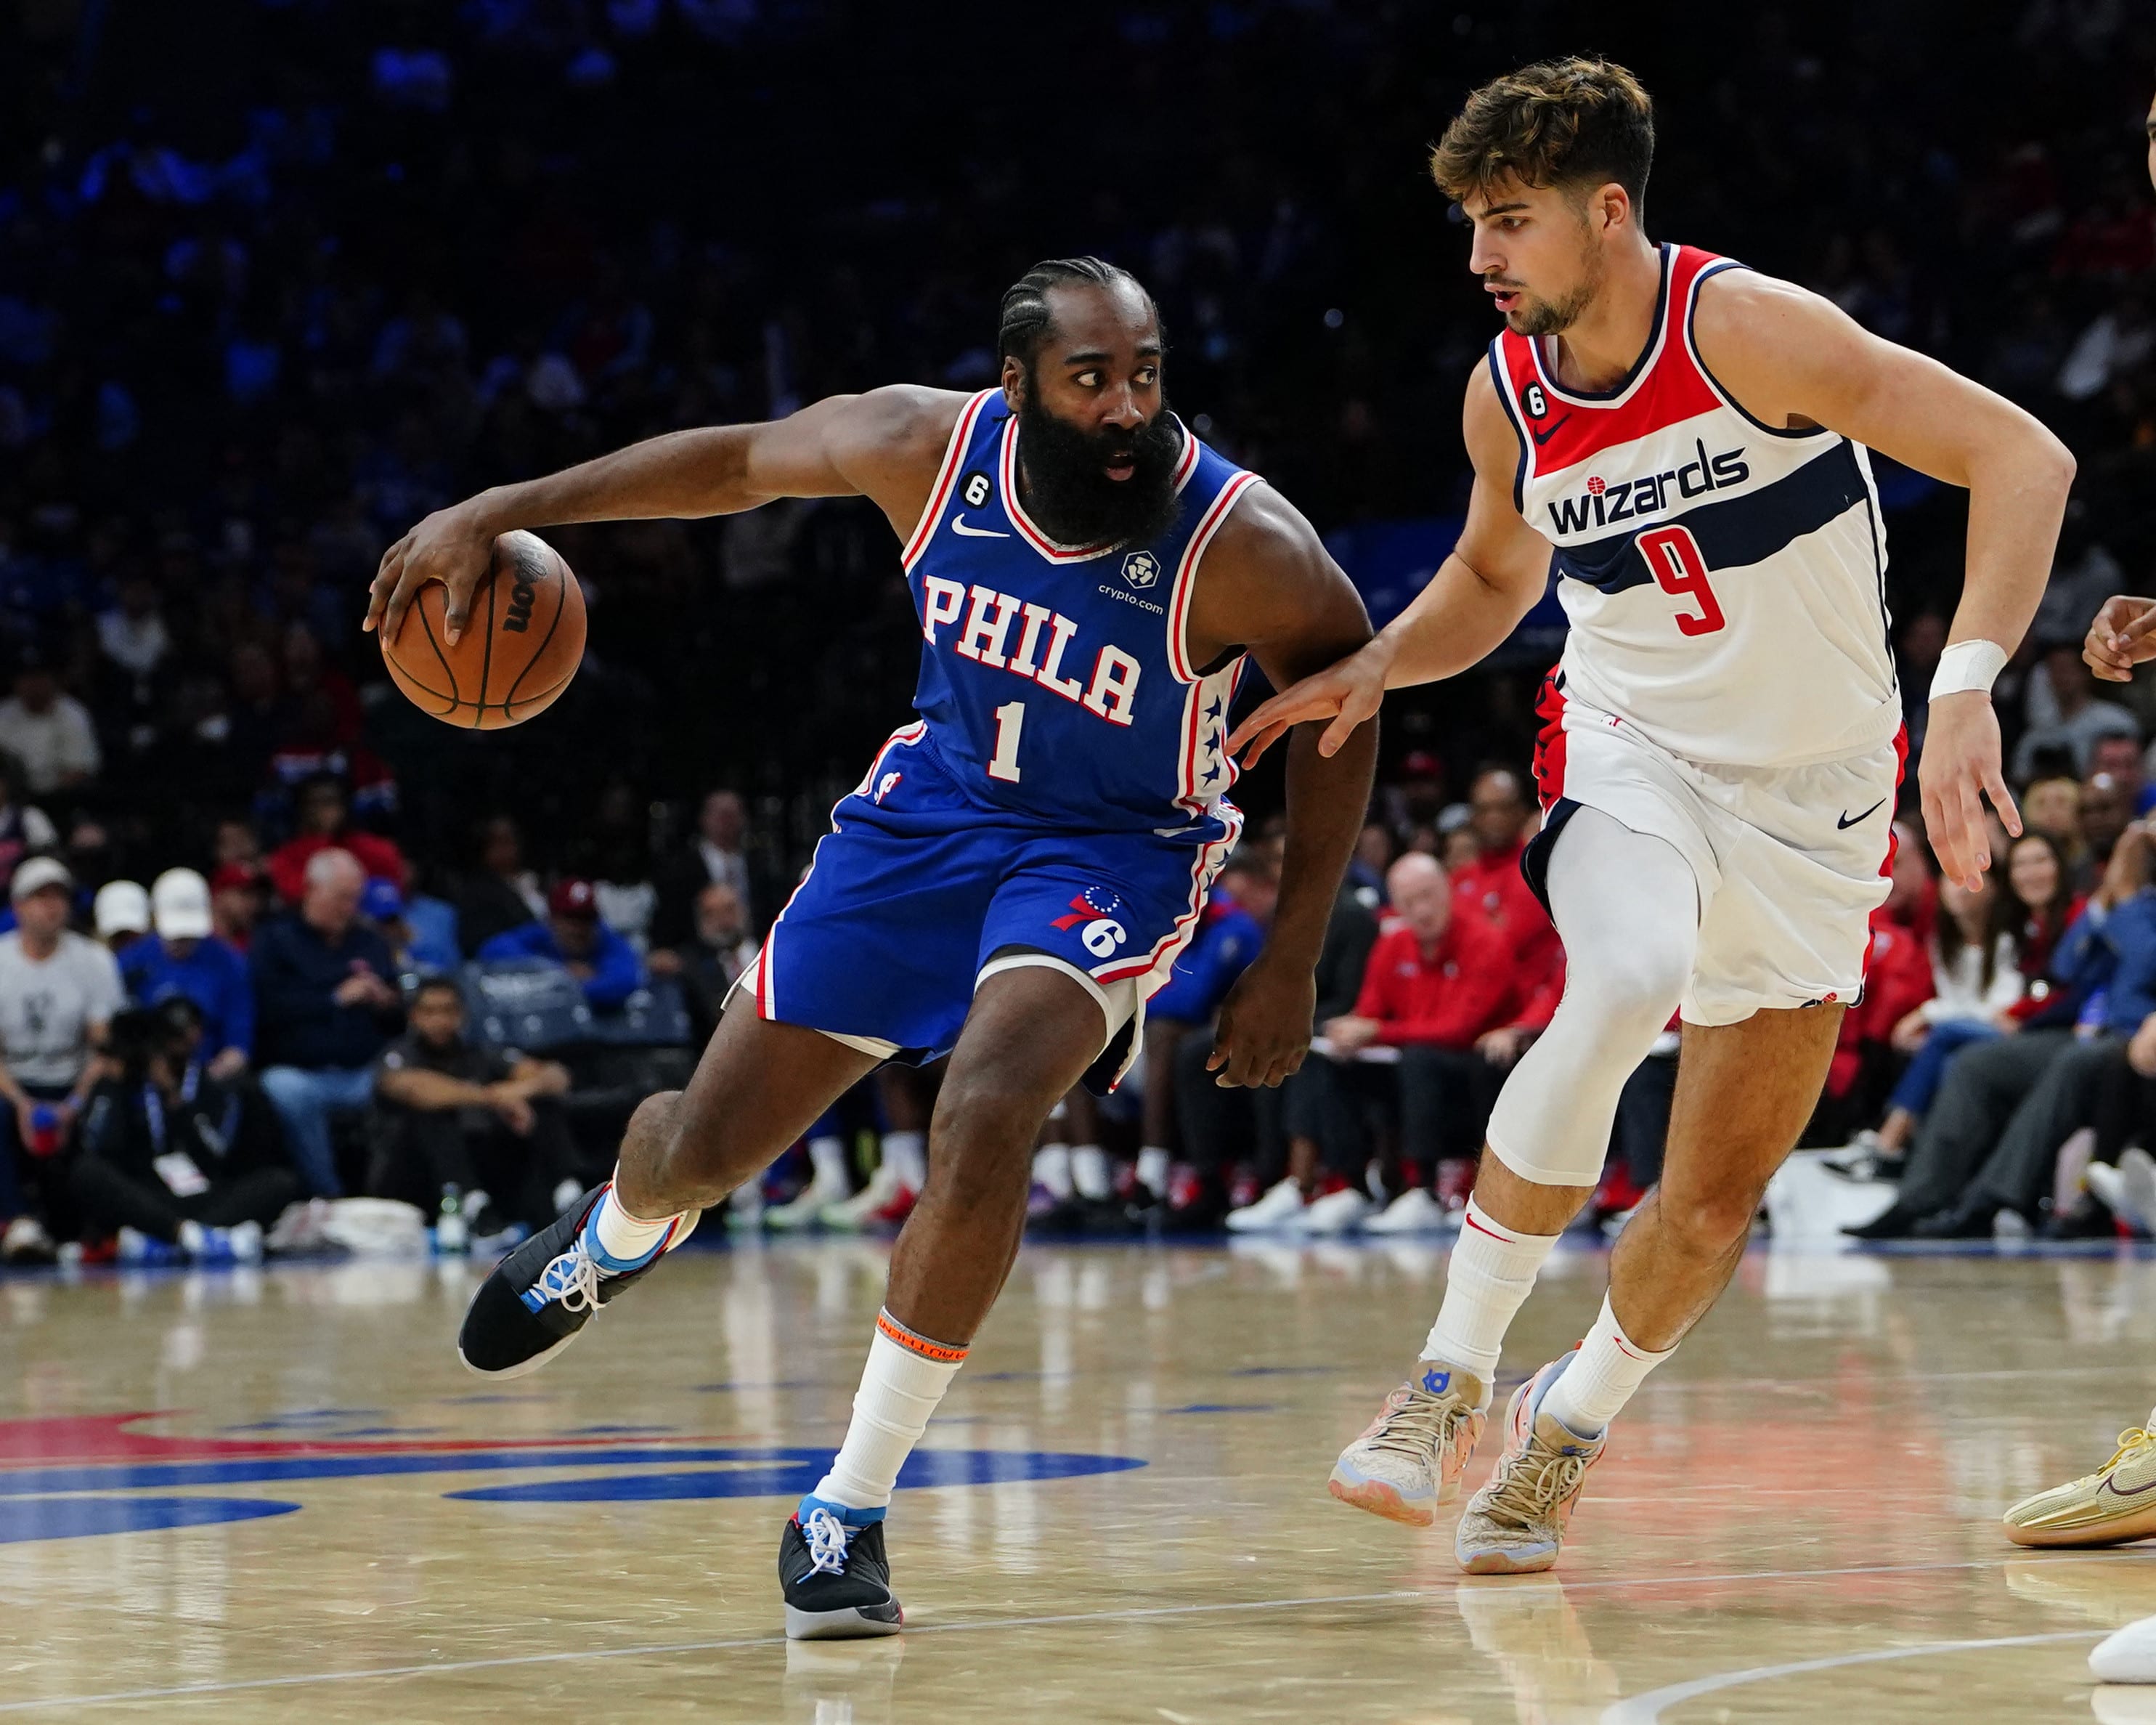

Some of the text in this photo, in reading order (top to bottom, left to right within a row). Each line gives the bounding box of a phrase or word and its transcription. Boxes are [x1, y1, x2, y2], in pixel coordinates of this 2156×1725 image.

[1528, 386, 1546, 416] 6
[965, 475, 989, 506] 6
[1098, 584, 1164, 616] crypto.com
[1635, 524, 1730, 638] 9
[922, 575, 1142, 727] PHILA
[987, 701, 1026, 784] 1
